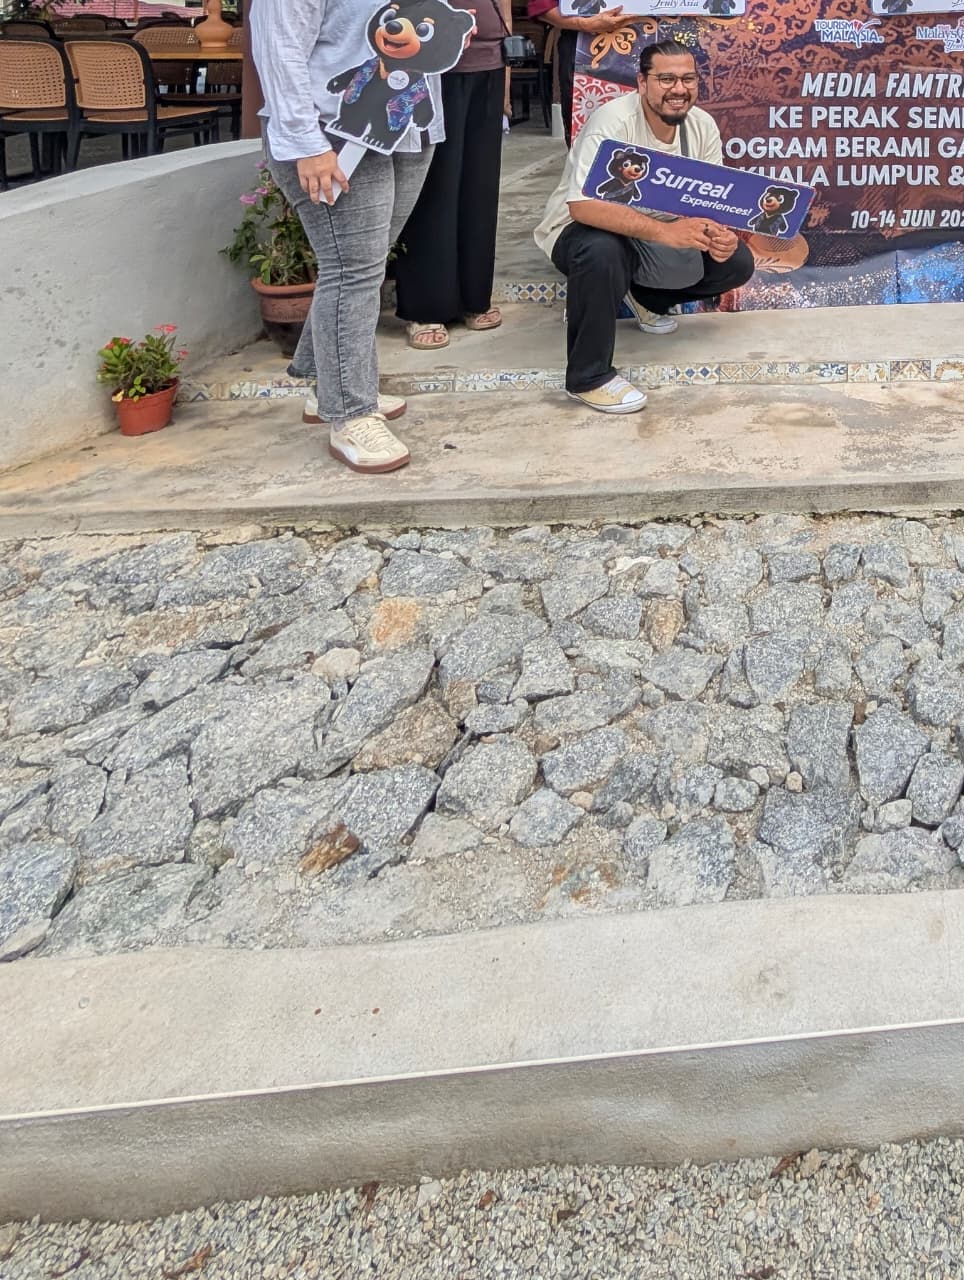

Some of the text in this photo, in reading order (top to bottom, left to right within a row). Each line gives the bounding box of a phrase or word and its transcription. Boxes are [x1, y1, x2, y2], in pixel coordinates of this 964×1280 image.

[815, 20, 854, 30] TOURISM
[822, 28, 879, 47] MALAYSIA
[801, 73, 876, 98] MEDIA
[769, 106, 803, 128] KE
[811, 106, 899, 128] PERAK
[721, 137, 827, 159] OGRAM
[835, 137, 930, 158] BERAMI
[650, 167, 734, 200] Surreal
[837, 165, 941, 186] LUMPUR
[680, 193, 753, 217] Experiences!
[851, 209, 896, 229] 10-14
[900, 209, 935, 228] JUN
